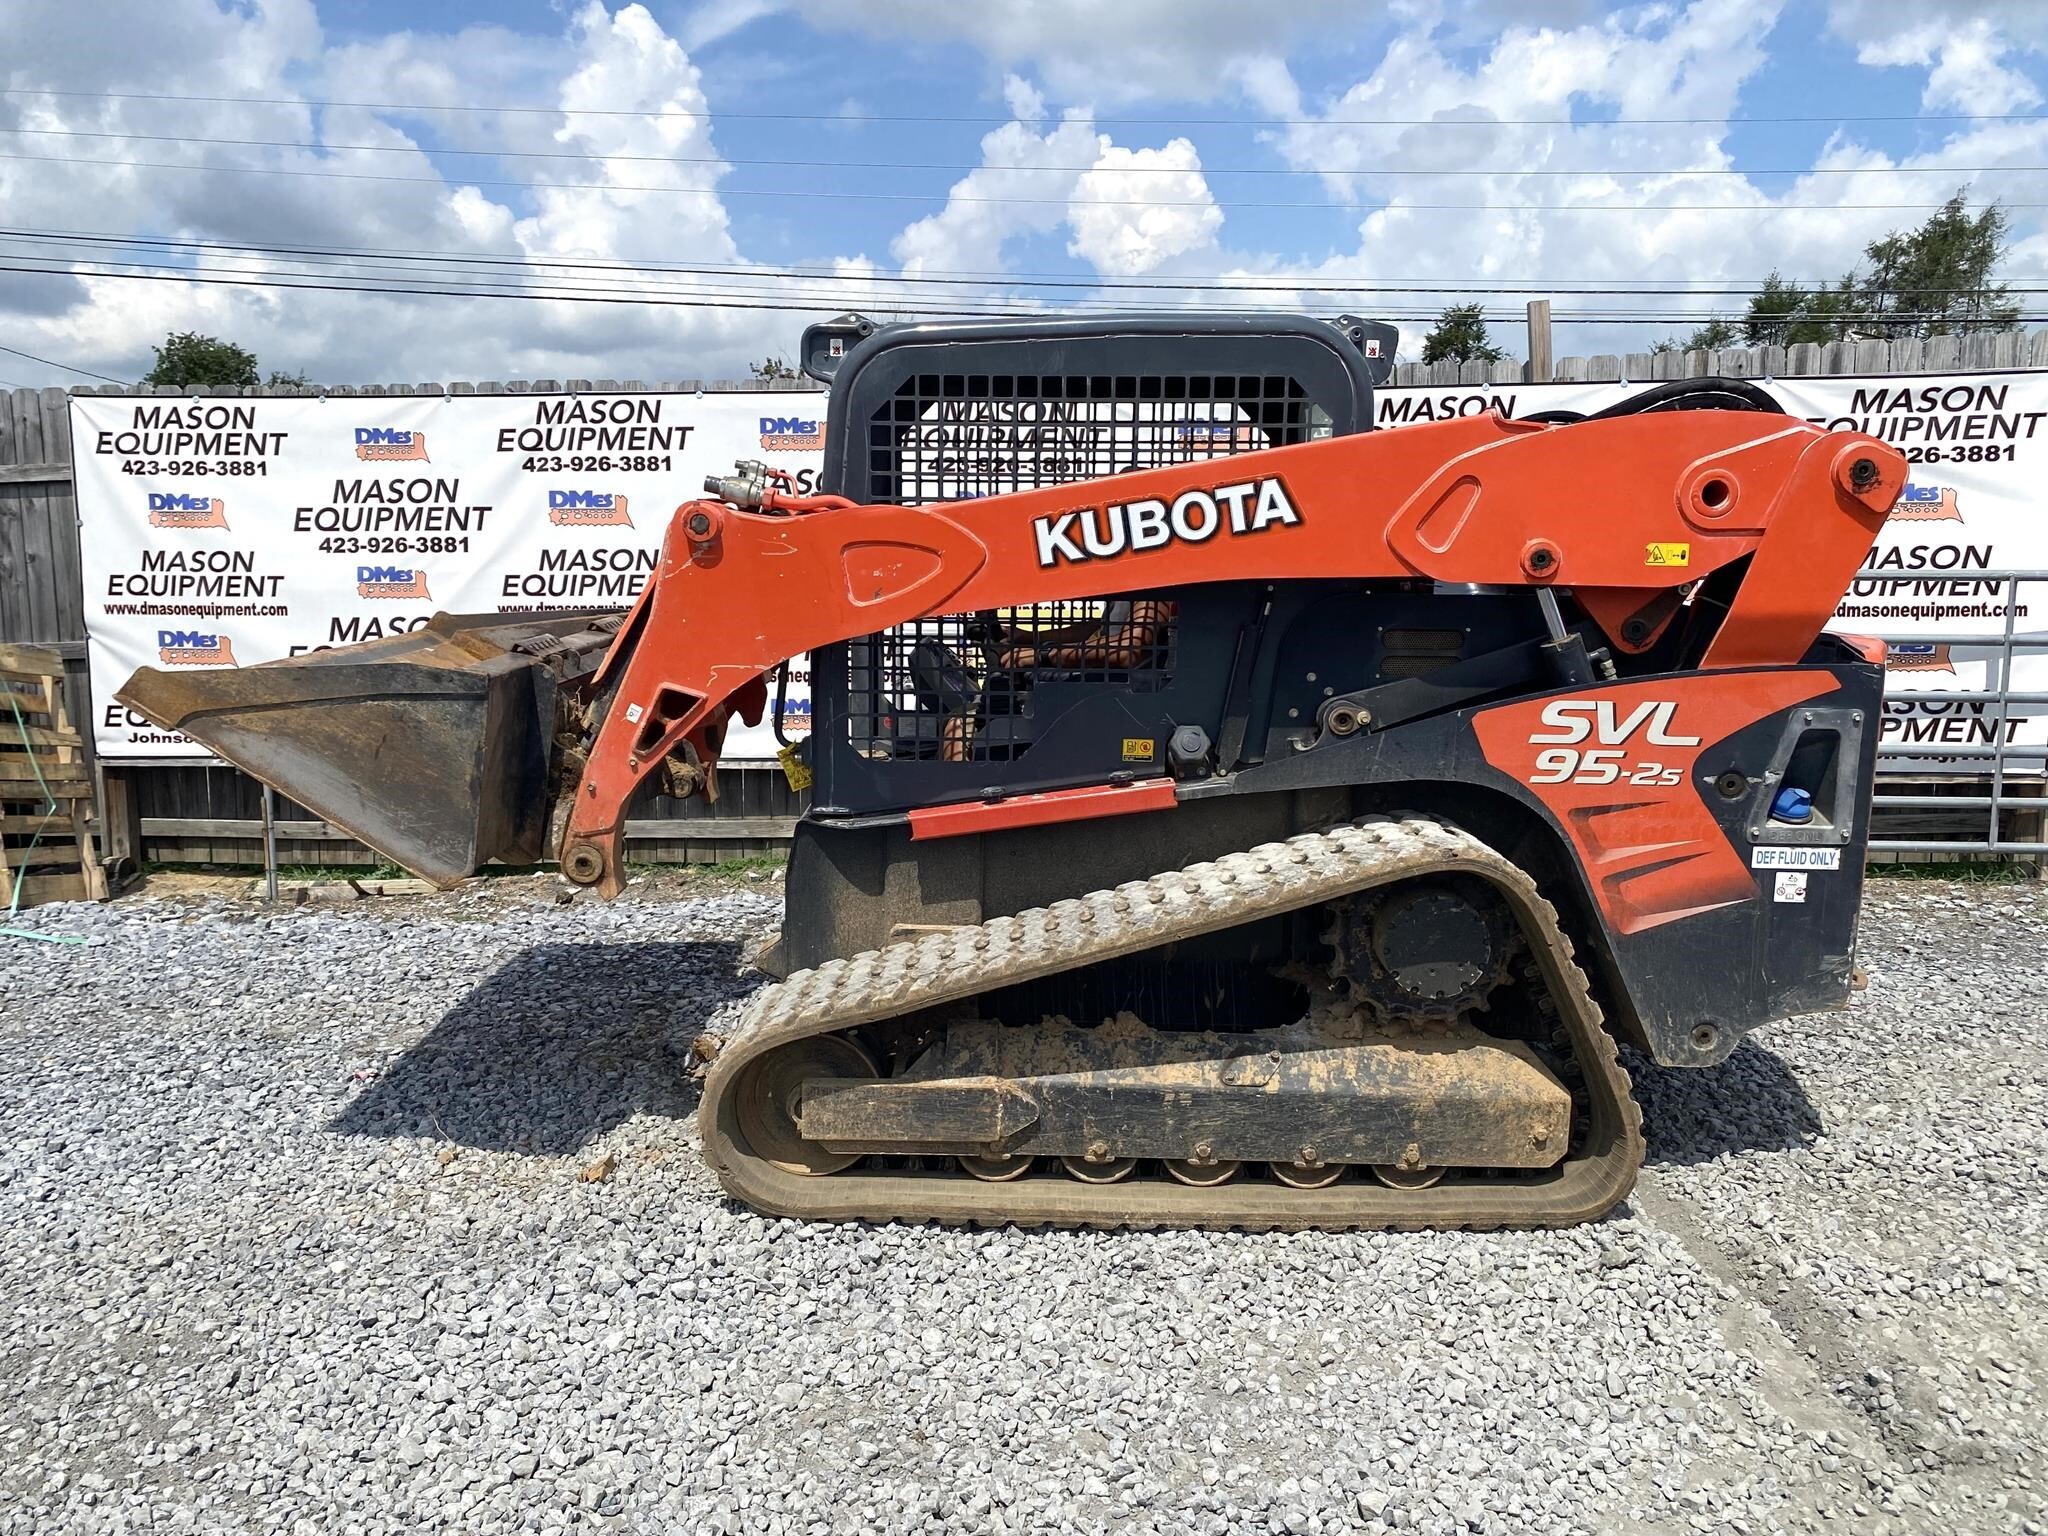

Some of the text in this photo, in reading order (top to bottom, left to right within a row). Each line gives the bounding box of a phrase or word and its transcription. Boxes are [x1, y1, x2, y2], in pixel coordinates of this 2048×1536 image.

[1379, 395, 1516, 422] MASON
[1850, 385, 2008, 414] MASON
[133, 406, 255, 429] MASON
[535, 400, 661, 424] MASON
[96, 431, 288, 456] EQUIPMENT
[497, 427, 694, 452] EQUIPMENT
[121, 460, 267, 476] 423-926-3881
[522, 456, 671, 472] 423-926-3881
[333, 479, 459, 504] MASON
[293, 507, 492, 532] EQUIPMENT
[1033, 478, 1300, 568] KUBOTA
[319, 537, 469, 553] 423-926-3881
[141, 550, 255, 572] MASON
[538, 549, 659, 571] MASON
[107, 574, 285, 597] EQUIPMENT
[502, 574, 647, 596] EQUIPME
[104, 602, 288, 619] www.dmasonequipment.com
[1528, 700, 1702, 746] SVL
[1756, 850, 1836, 866] DEF FLUID ONLY
